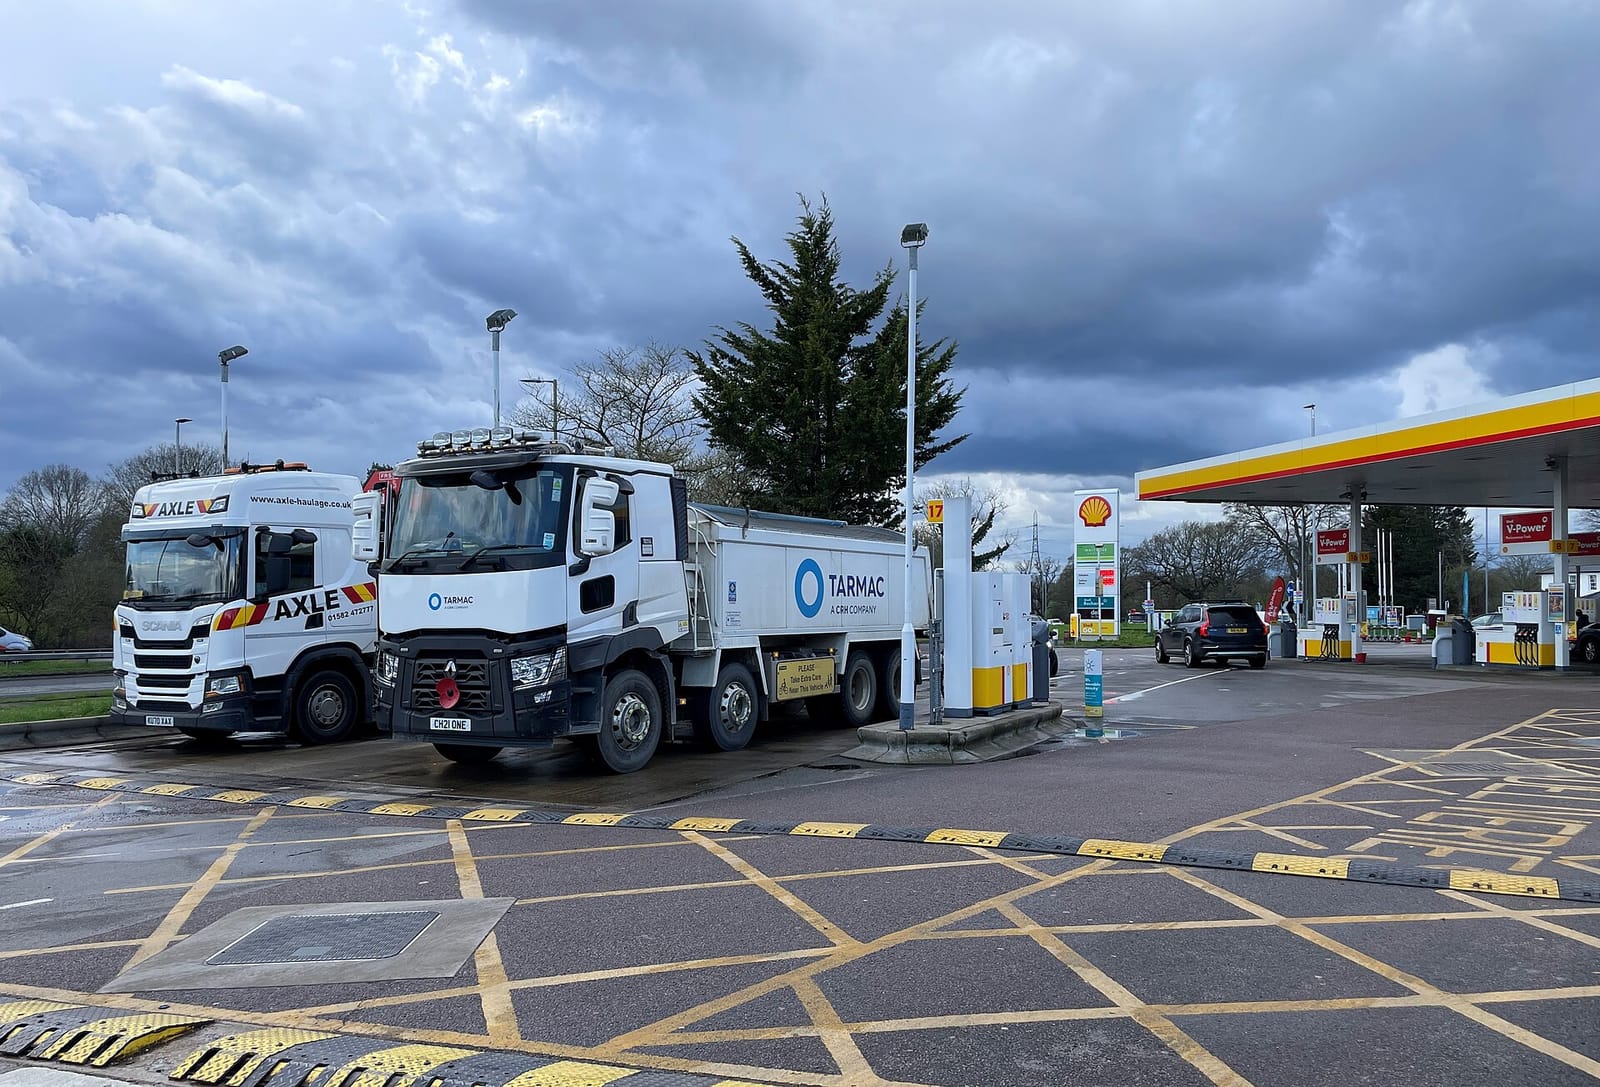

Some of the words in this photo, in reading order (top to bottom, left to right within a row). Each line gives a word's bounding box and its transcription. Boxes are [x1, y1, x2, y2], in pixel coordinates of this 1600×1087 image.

[158, 500, 195, 516] AXLE
[250, 496, 352, 509] www.axle-haulage.co.uk
[929, 504, 943, 518] 17
[1506, 524, 1546, 534] V-Power
[828, 574, 885, 597] TARMAC
[274, 589, 340, 621] AXLE
[443, 596, 474, 604] TARMAC
[830, 605, 835, 614] A
[836, 605, 848, 614] CRH
[849, 605, 877, 614] COMPANY
[327, 612, 349, 622] 01582
[142, 621, 183, 632] SCANIA
[798, 663, 816, 672] PLEASE
[434, 719, 451, 729] CH21
[451, 720, 467, 730] ONE
